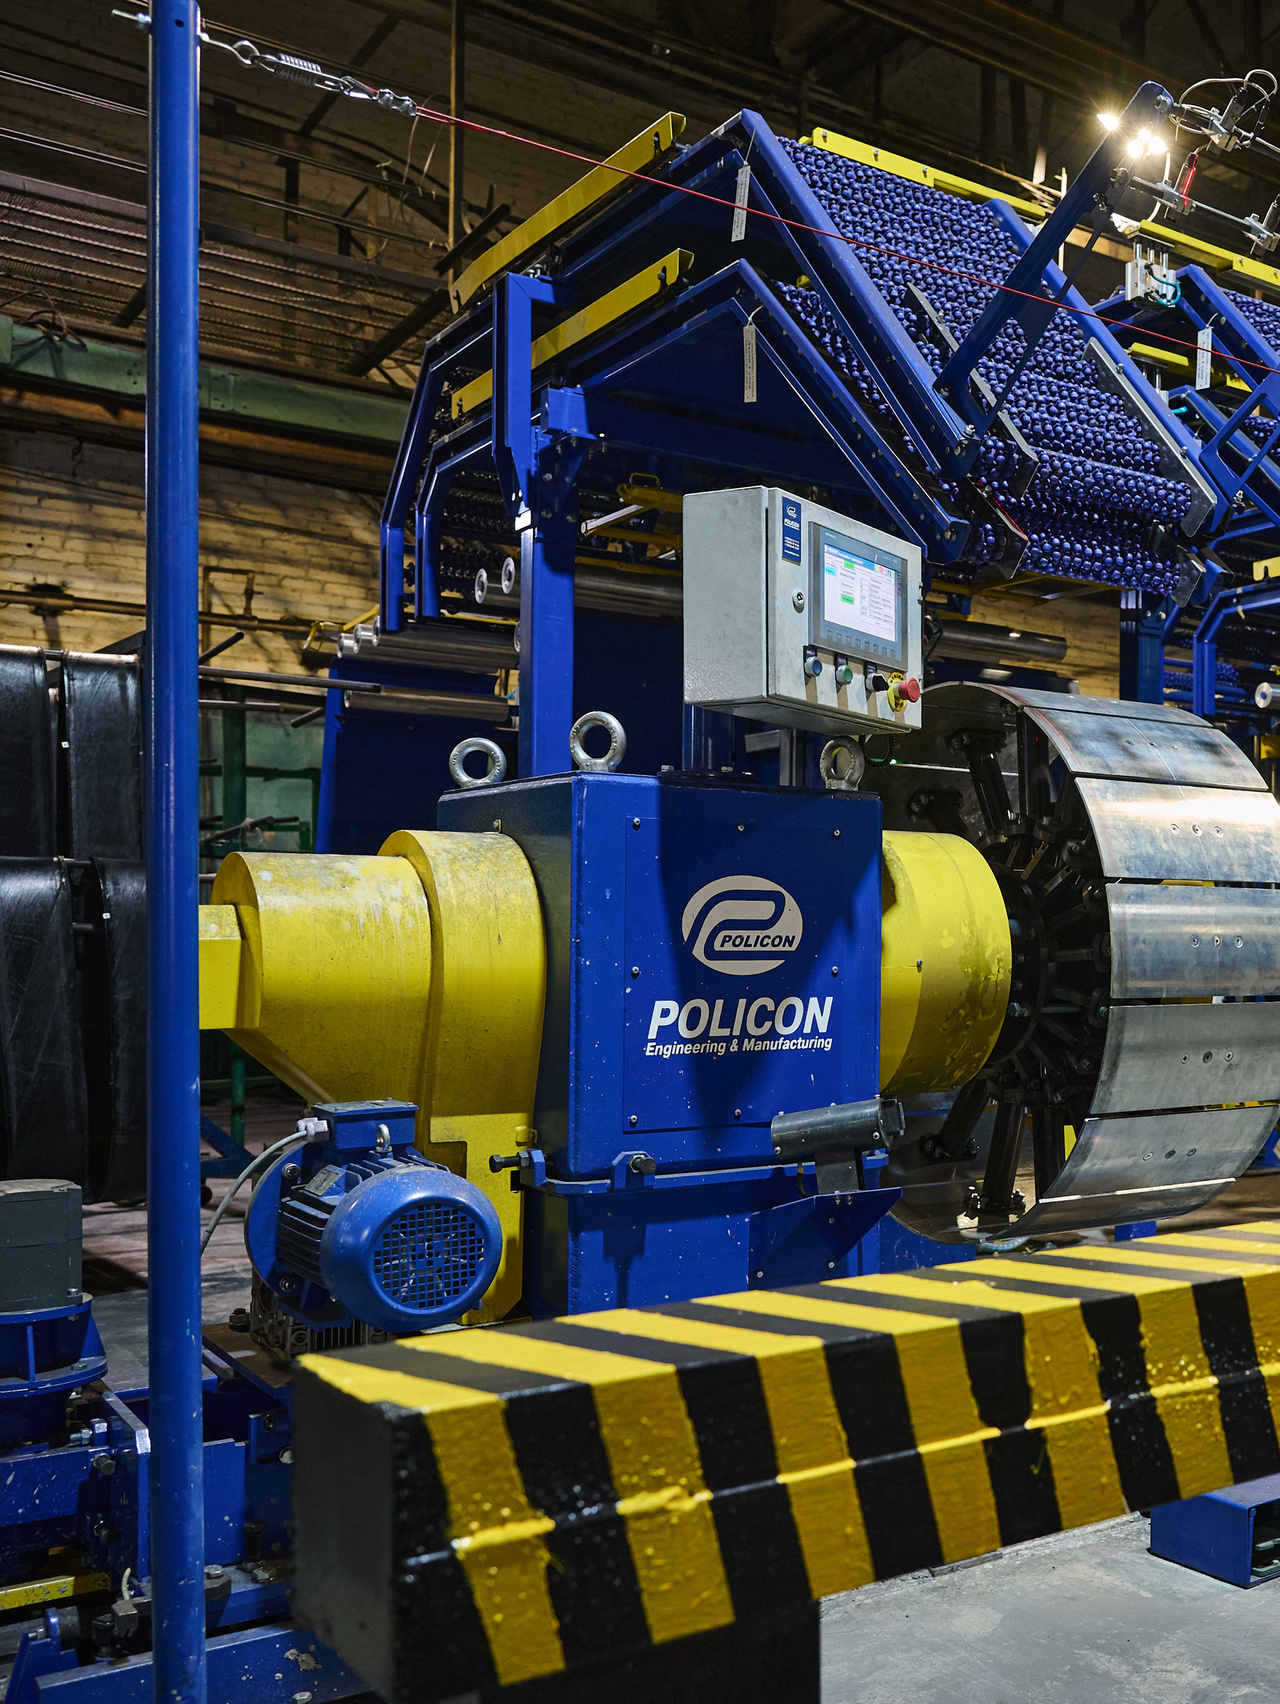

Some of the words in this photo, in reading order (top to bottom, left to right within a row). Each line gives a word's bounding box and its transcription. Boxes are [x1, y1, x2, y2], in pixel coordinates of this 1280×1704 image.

[720, 934, 796, 948] POLICON
[647, 996, 834, 1040] POLICON
[645, 1039, 727, 1059] Engineering
[729, 1038, 739, 1053] &
[742, 1035, 833, 1052] Manufacturing
